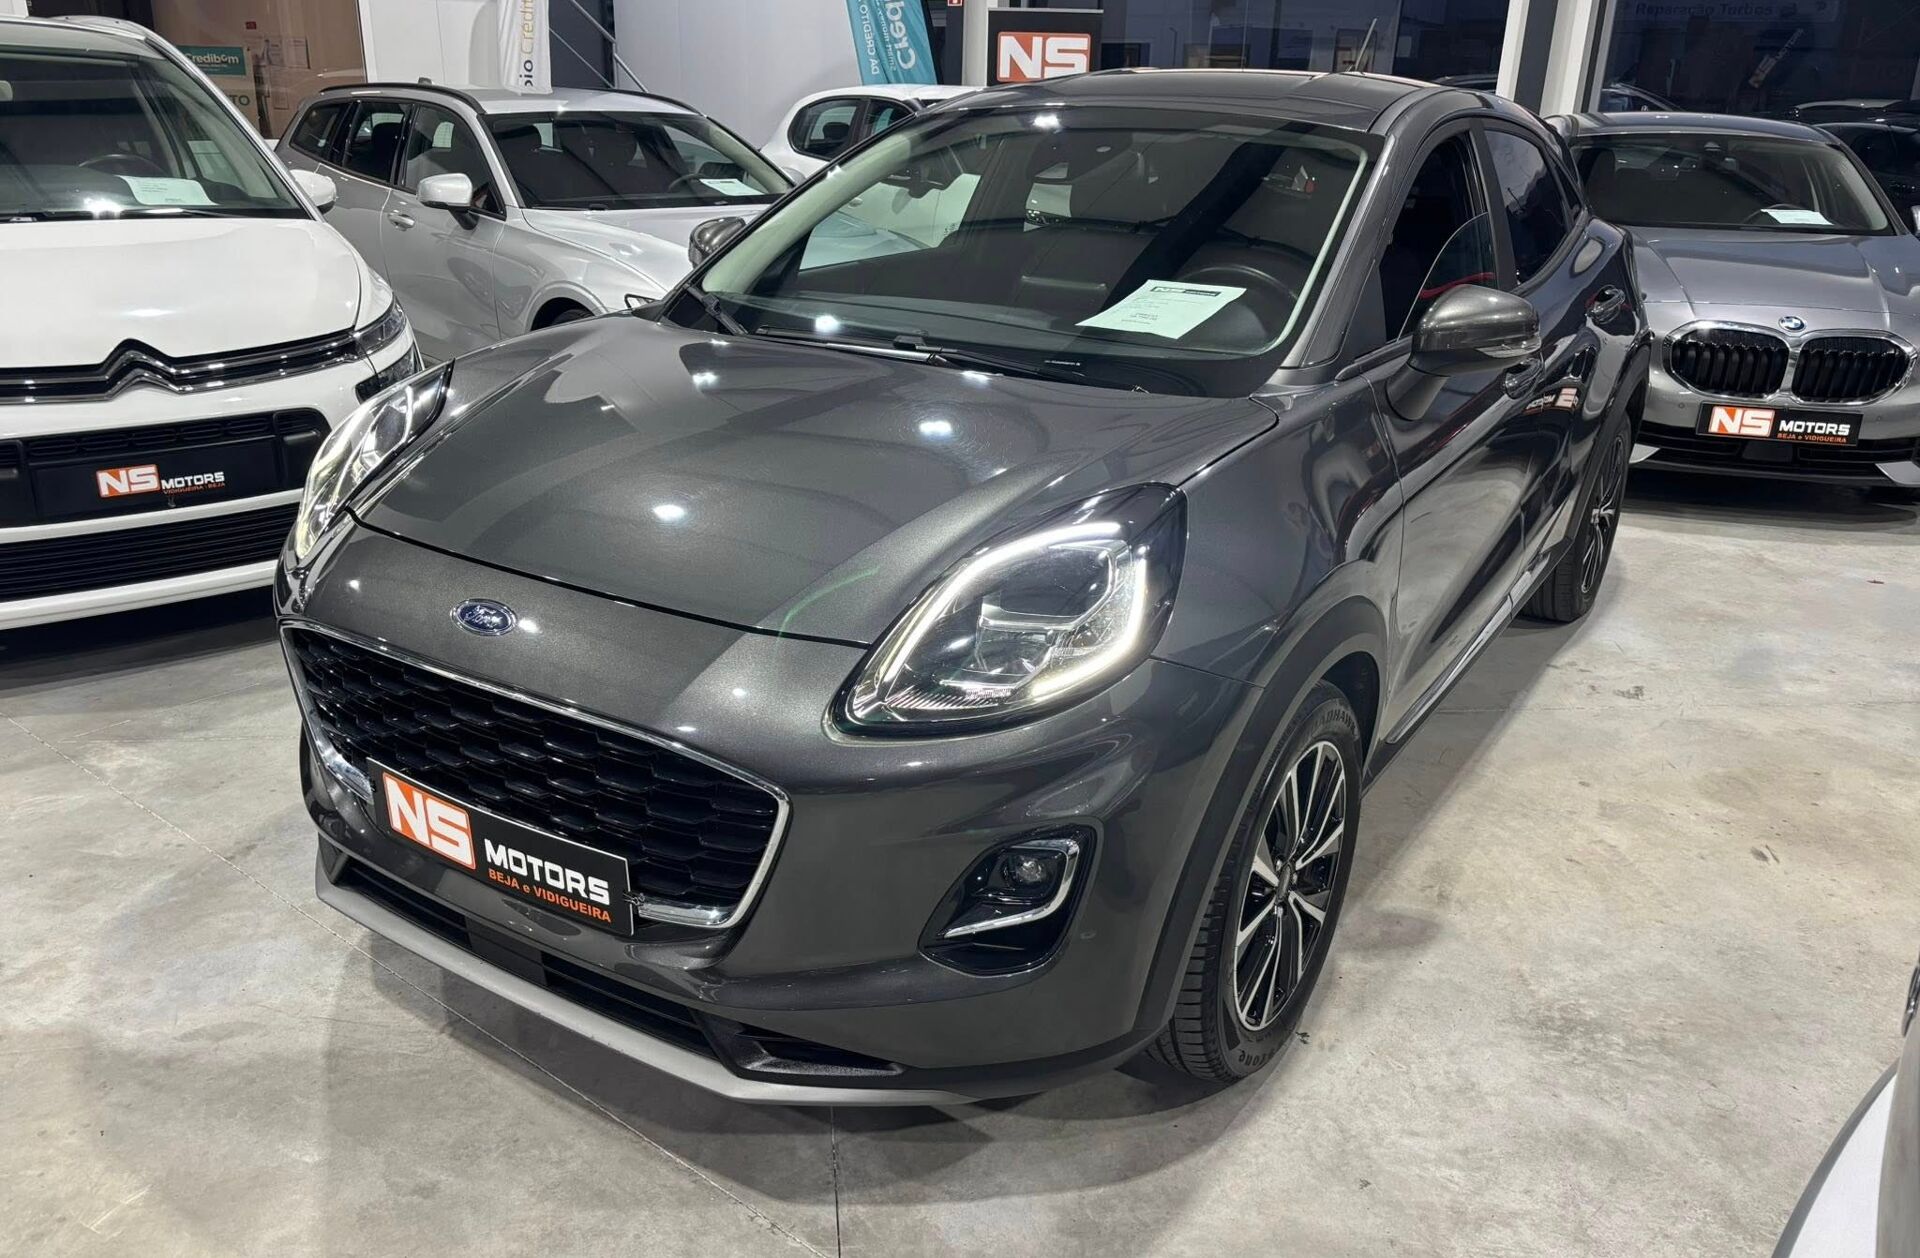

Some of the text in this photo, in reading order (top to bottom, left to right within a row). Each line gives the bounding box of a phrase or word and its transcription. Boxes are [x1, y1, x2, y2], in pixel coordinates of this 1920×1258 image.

[1000, 36, 1088, 78] NS
[229, 95, 250, 106] TO
[1709, 406, 1774, 438] NS
[1779, 420, 1851, 436] MOTORS
[99, 466, 158, 497] NS
[161, 472, 225, 490] MOTORS
[385, 775, 473, 867] NS
[484, 838, 611, 906] MOTORS
[488, 868, 612, 924] BEJA e VIDIGUEIRA
